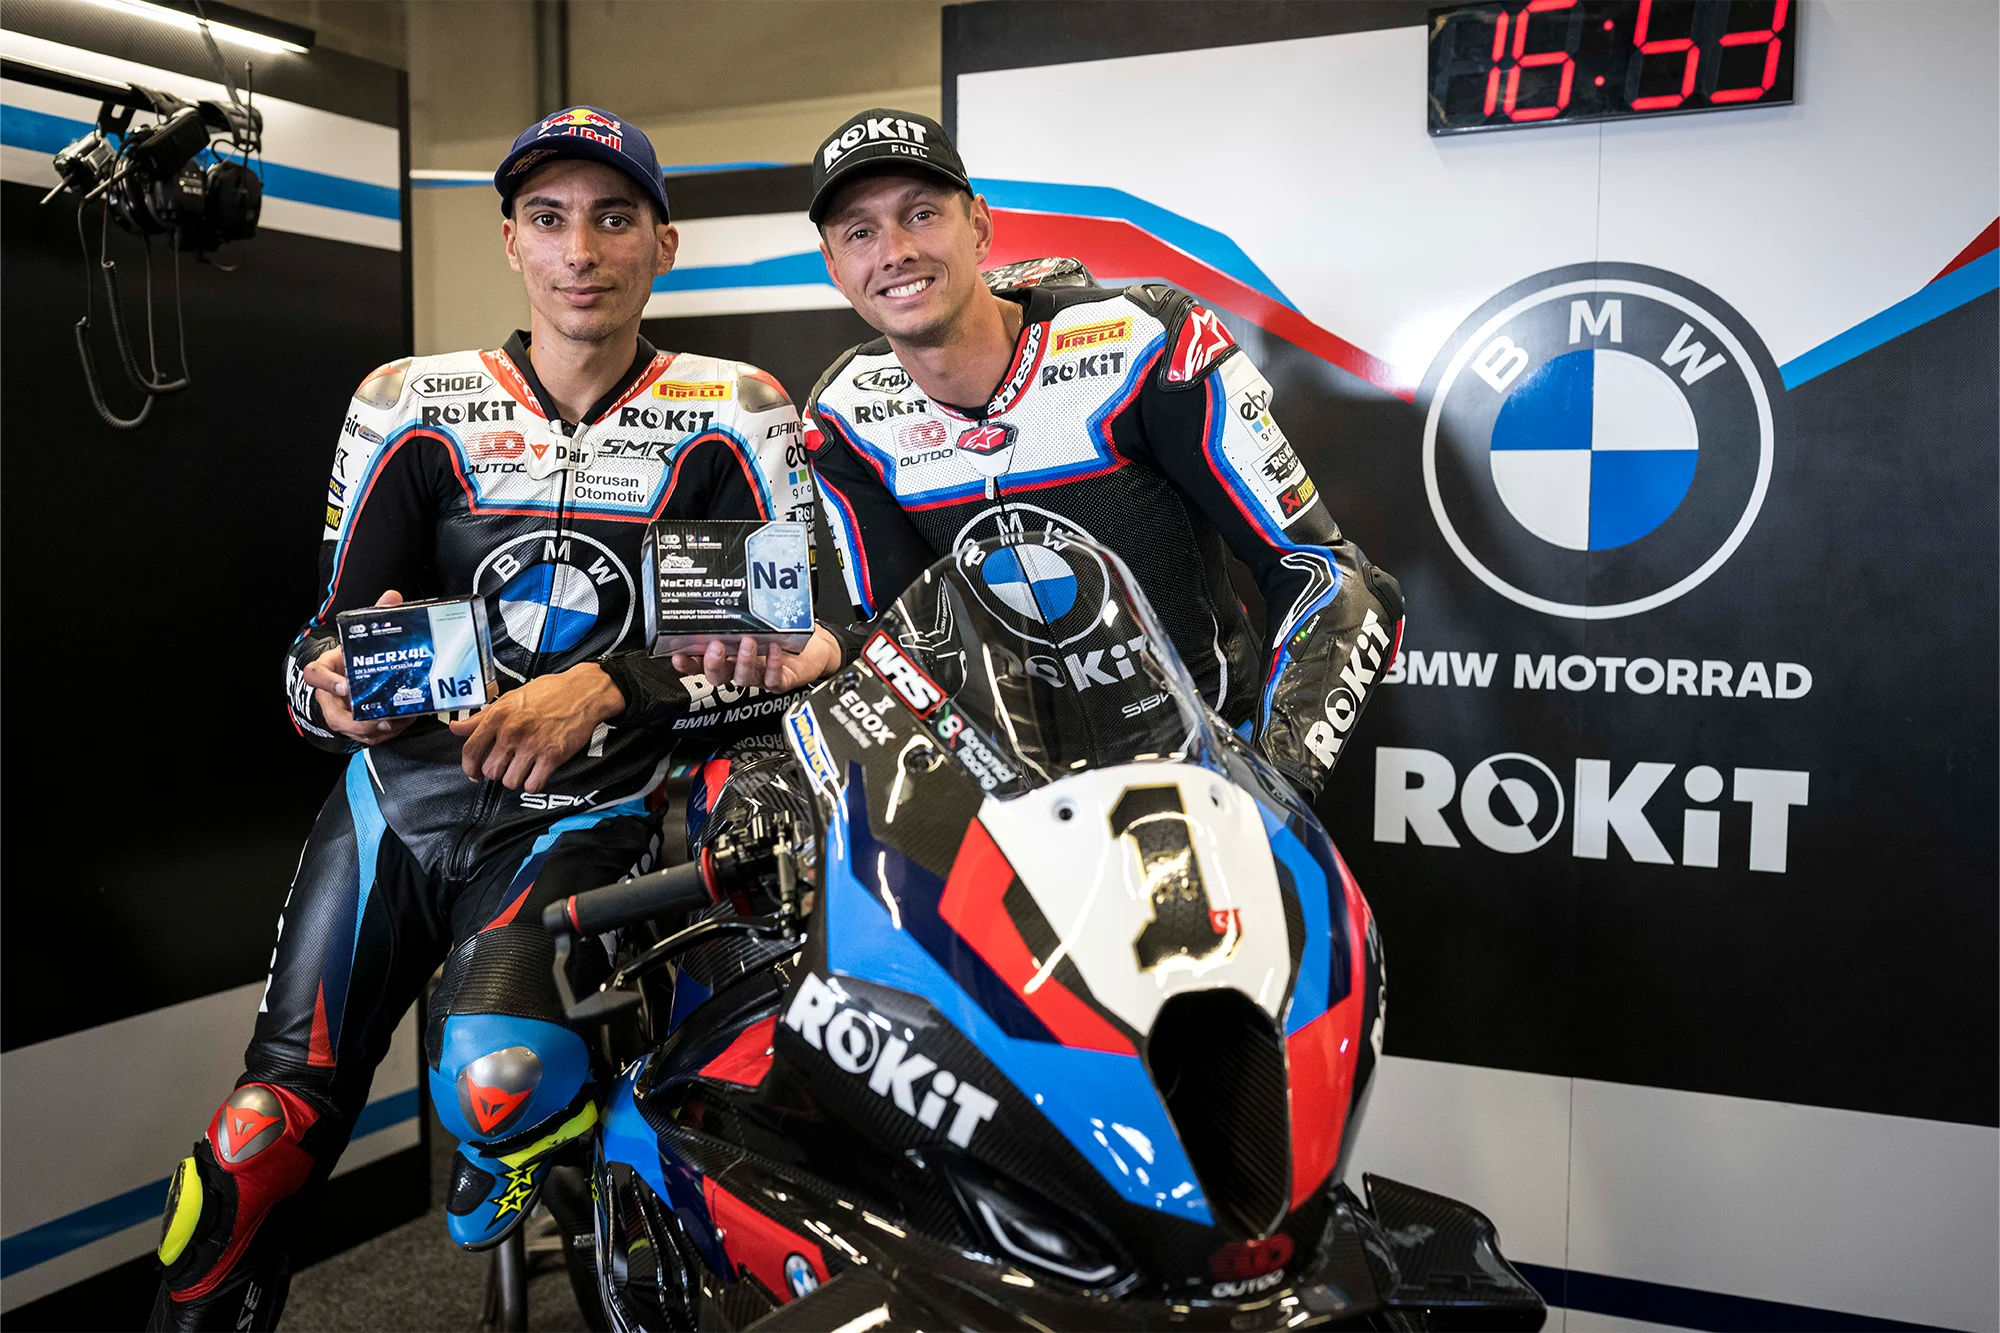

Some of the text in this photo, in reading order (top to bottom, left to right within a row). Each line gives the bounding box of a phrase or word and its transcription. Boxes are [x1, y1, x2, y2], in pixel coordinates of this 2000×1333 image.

[824, 118, 927, 169] ROKiT
[891, 144, 927, 158] FUEL
[1056, 321, 1126, 351] PIRELLI
[1471, 299, 1727, 393] BMW
[860, 369, 906, 388] Arai
[987, 323, 1042, 415] alpinestars
[1042, 351, 1124, 387] ROKiT
[423, 376, 482, 393] SHOEI
[659, 384, 724, 398] PIRELLI
[422, 400, 516, 427] ROKiT
[619, 407, 714, 433] ROKiT
[855, 399, 927, 424] ROKiT
[597, 439, 676, 467] SMR
[900, 449, 953, 467] OUTDO
[575, 471, 639, 487] Borusan
[574, 486, 645, 503] Otomotiv
[964, 512, 1072, 567] BMW
[491, 540, 620, 586] BMW
[353, 647, 430, 667] NaCRX4L
[1304, 608, 1390, 769] ROKiT
[1386, 651, 1813, 699] BMW MOTORRAD
[672, 712, 721, 730] BMW
[839, 690, 897, 746] EDOX
[1374, 746, 1809, 873] ROKiT
[1107, 782, 1242, 974] 1
[785, 972, 999, 1149] ROKiT
